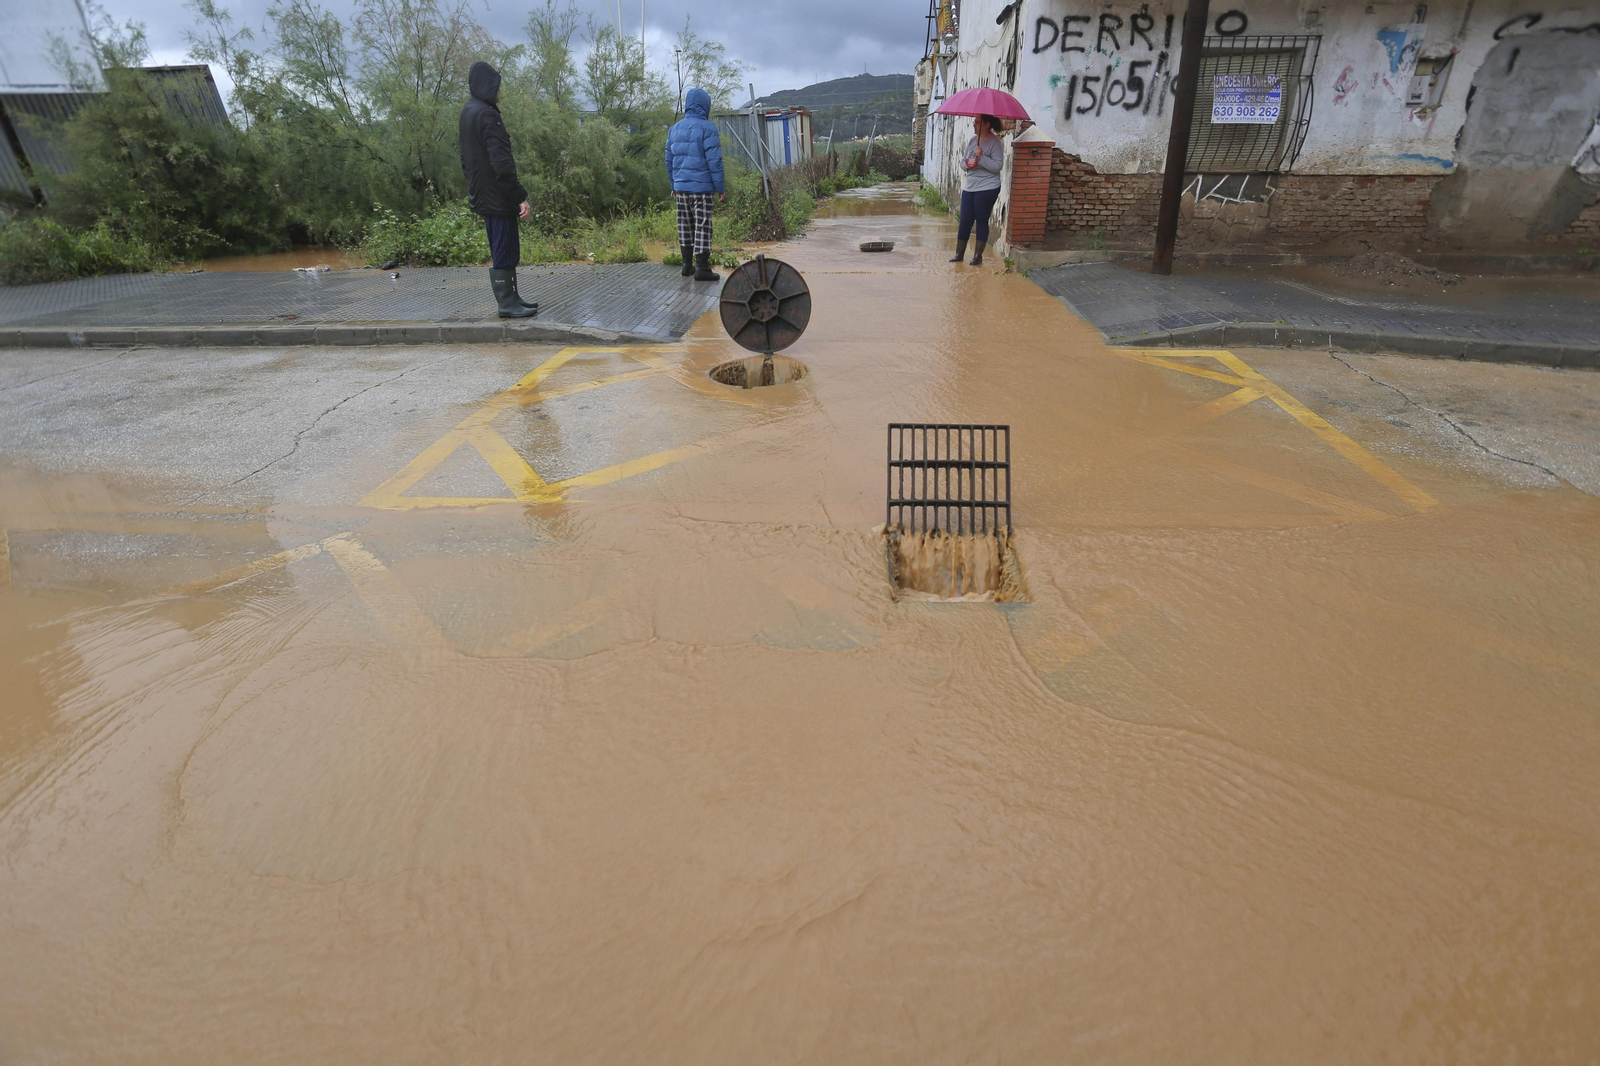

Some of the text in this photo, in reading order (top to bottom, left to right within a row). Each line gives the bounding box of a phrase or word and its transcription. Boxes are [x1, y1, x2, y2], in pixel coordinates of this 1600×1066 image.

[1031, 9, 1248, 55] DERRIO
[1213, 106, 1278, 117] 630 908 262
